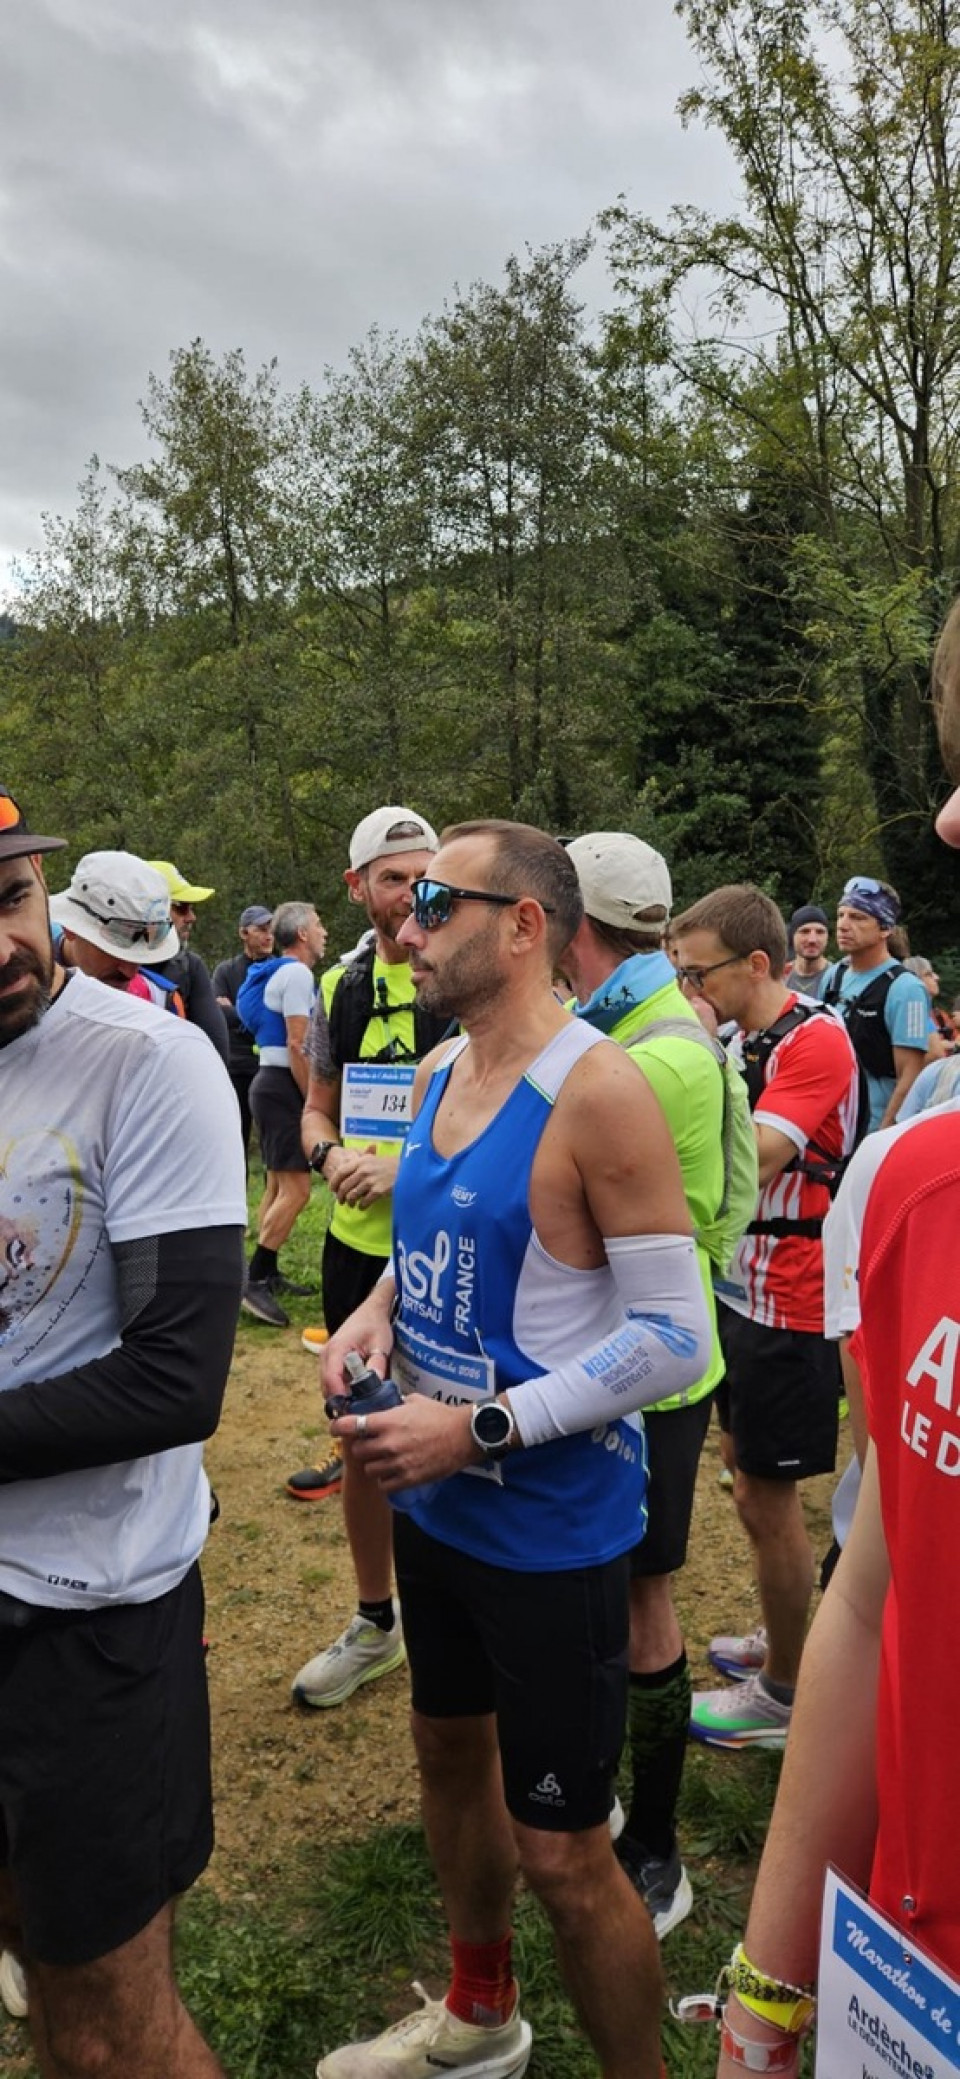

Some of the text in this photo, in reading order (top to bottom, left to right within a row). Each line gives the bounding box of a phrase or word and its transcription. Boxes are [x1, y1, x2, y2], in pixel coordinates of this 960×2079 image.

[381, 1094, 408, 1113] 134
[454, 1235, 476, 1337] FRANCE
[905, 1315, 960, 1412] A
[900, 1400, 933, 1459] LE
[845, 1920, 952, 2034] Marathon de
[848, 1994, 925, 2079] Ardèche
